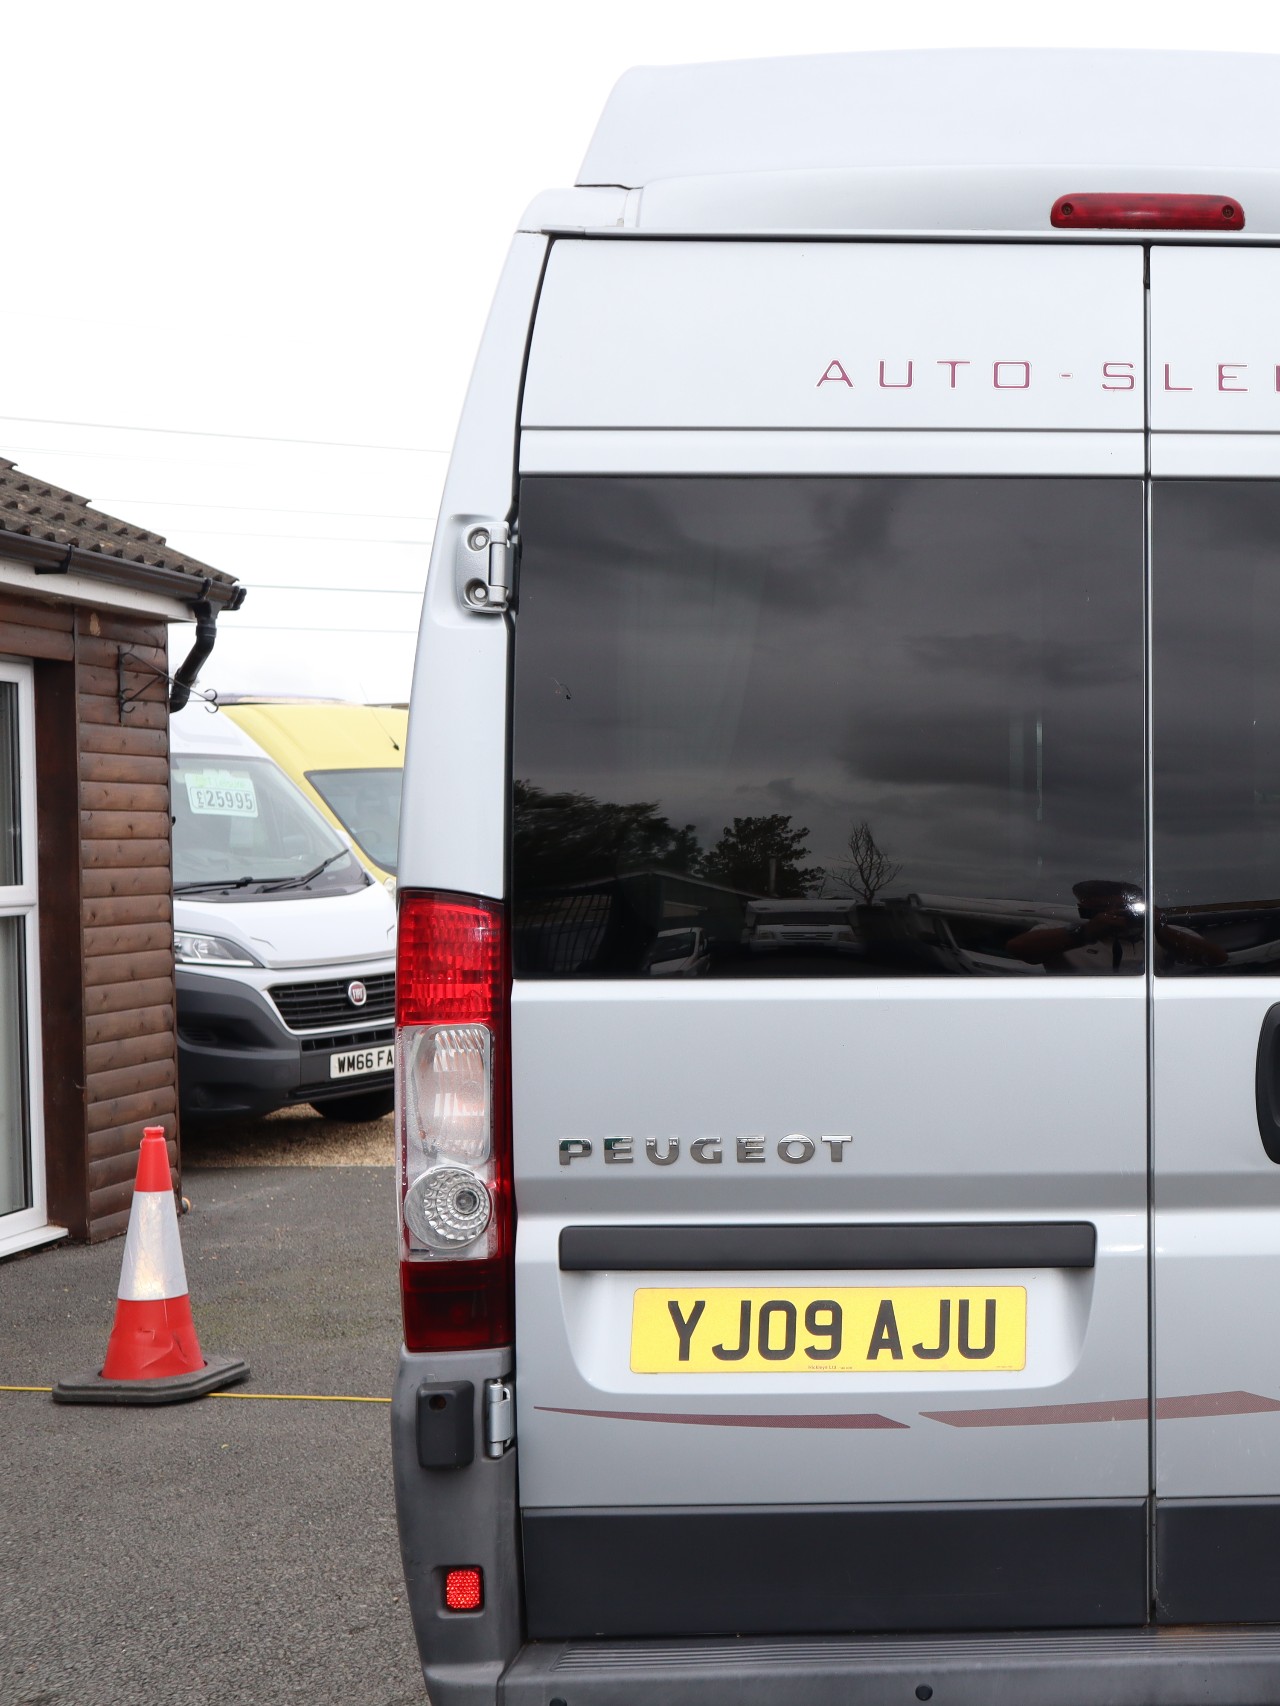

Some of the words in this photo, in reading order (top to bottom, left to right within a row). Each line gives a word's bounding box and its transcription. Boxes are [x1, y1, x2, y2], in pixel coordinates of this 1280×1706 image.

[197, 790, 253, 810] £25995
[337, 1052, 374, 1073] WM66
[377, 1049, 394, 1067] FA
[558, 1133, 853, 1166] PEUGEOT
[667, 1299, 843, 1361] YJ09
[866, 1298, 997, 1360] AJU
